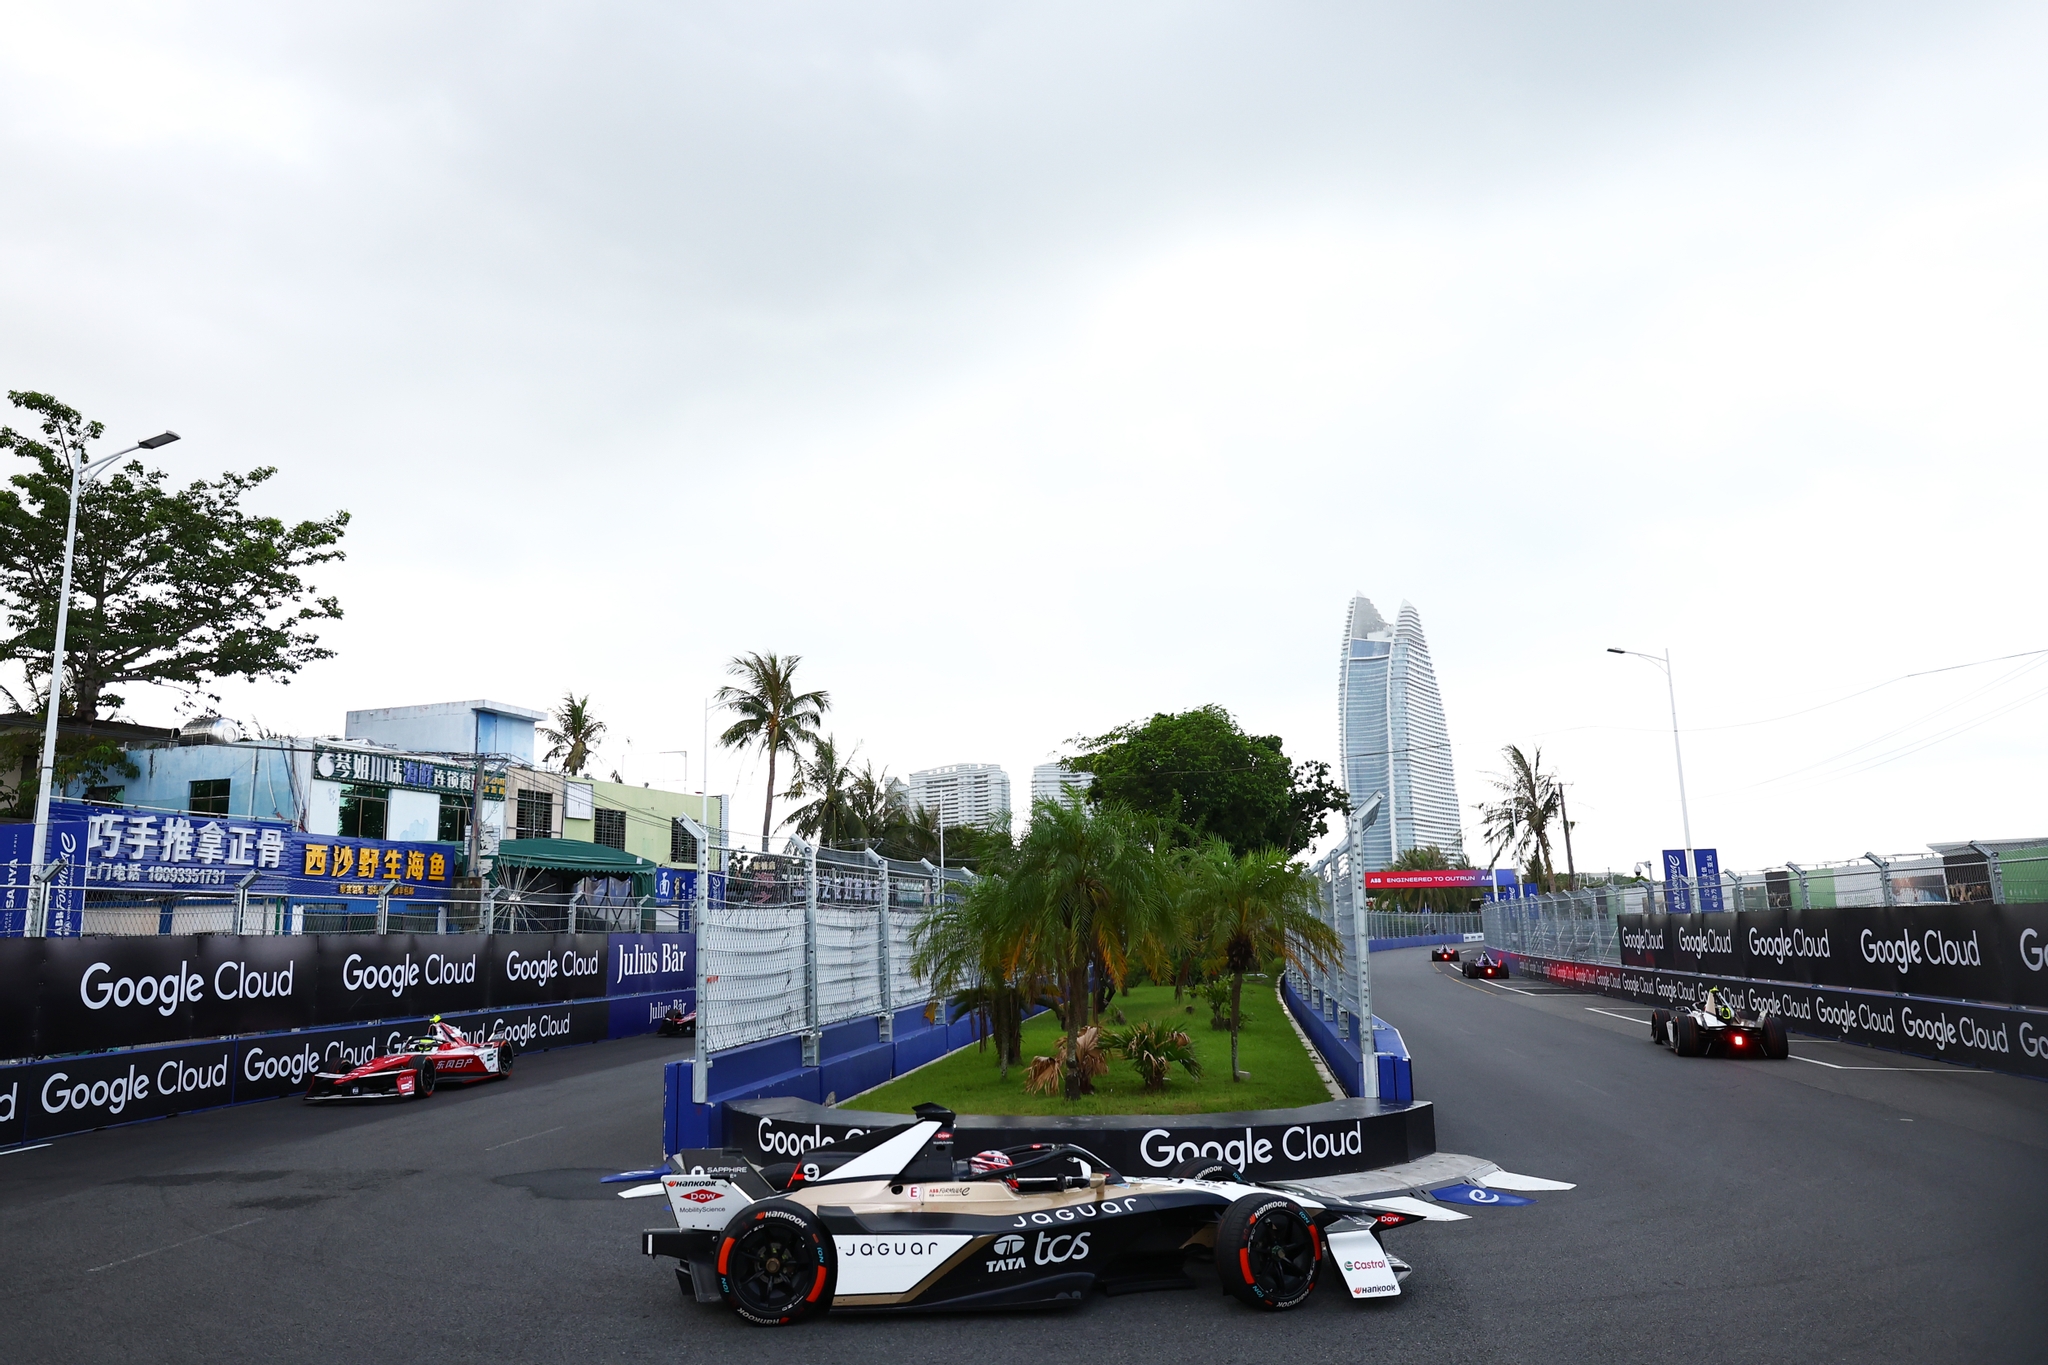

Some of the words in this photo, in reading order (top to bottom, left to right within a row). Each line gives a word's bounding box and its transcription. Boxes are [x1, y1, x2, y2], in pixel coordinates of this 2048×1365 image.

[335, 753, 475, 791] 琴姐川味海鲜连锁餐
[87, 813, 285, 868] 巧手推拿正骨
[304, 843, 446, 881] 西沙野生海鱼
[5, 858, 19, 909] SANYA
[54, 911, 64, 936] ABB
[1622, 926, 1645, 955] Google
[1645, 928, 1665, 951] Cloud
[1678, 926, 1708, 959] Google
[1707, 928, 1733, 954] Cloud
[1748, 926, 1794, 965] Google
[1793, 928, 1831, 958] Cloud
[1860, 928, 1922, 974] Google
[1924, 929, 1981, 967] Cloud
[342, 953, 419, 998] Google
[425, 953, 476, 985] Cloud
[505, 950, 557, 987] Google
[562, 950, 598, 978] Cloud
[616, 944, 658, 984] Julius
[661, 943, 687, 973] Bär
[1596, 969, 1610, 991] Google
[1609, 972, 1621, 989] Cloud
[80, 960, 205, 1017] Google
[214, 960, 294, 1000] Cloud
[1622, 972, 1640, 996] Google
[1639, 975, 1654, 995] Cloud
[1655, 975, 1677, 1003] Google
[1677, 979, 1696, 1001] Cloud
[1723, 986, 1746, 1009] Cloud
[1748, 988, 1781, 1018] Google
[1782, 994, 1811, 1021] Cloud
[1816, 996, 1858, 1034] Google
[1859, 1000, 1896, 1035] Cloud
[539, 1012, 570, 1038] Cloud
[1901, 1006, 1957, 1051] Google
[1959, 1017, 2010, 1054] Cloud
[244, 1043, 320, 1084] Google
[435, 1058, 474, 1070] 东风日产
[41, 1064, 149, 1115] Google
[157, 1054, 228, 1096] Cloud
[1140, 1128, 1273, 1175] Google
[1282, 1121, 1363, 1162] Cloud
[803, 1163, 820, 1182] 9
[910, 1186, 918, 1198] E
[985, 1256, 1027, 1273] TATA
[1033, 1230, 1092, 1266] tcs
[1353, 1259, 1386, 1271] Castrol
